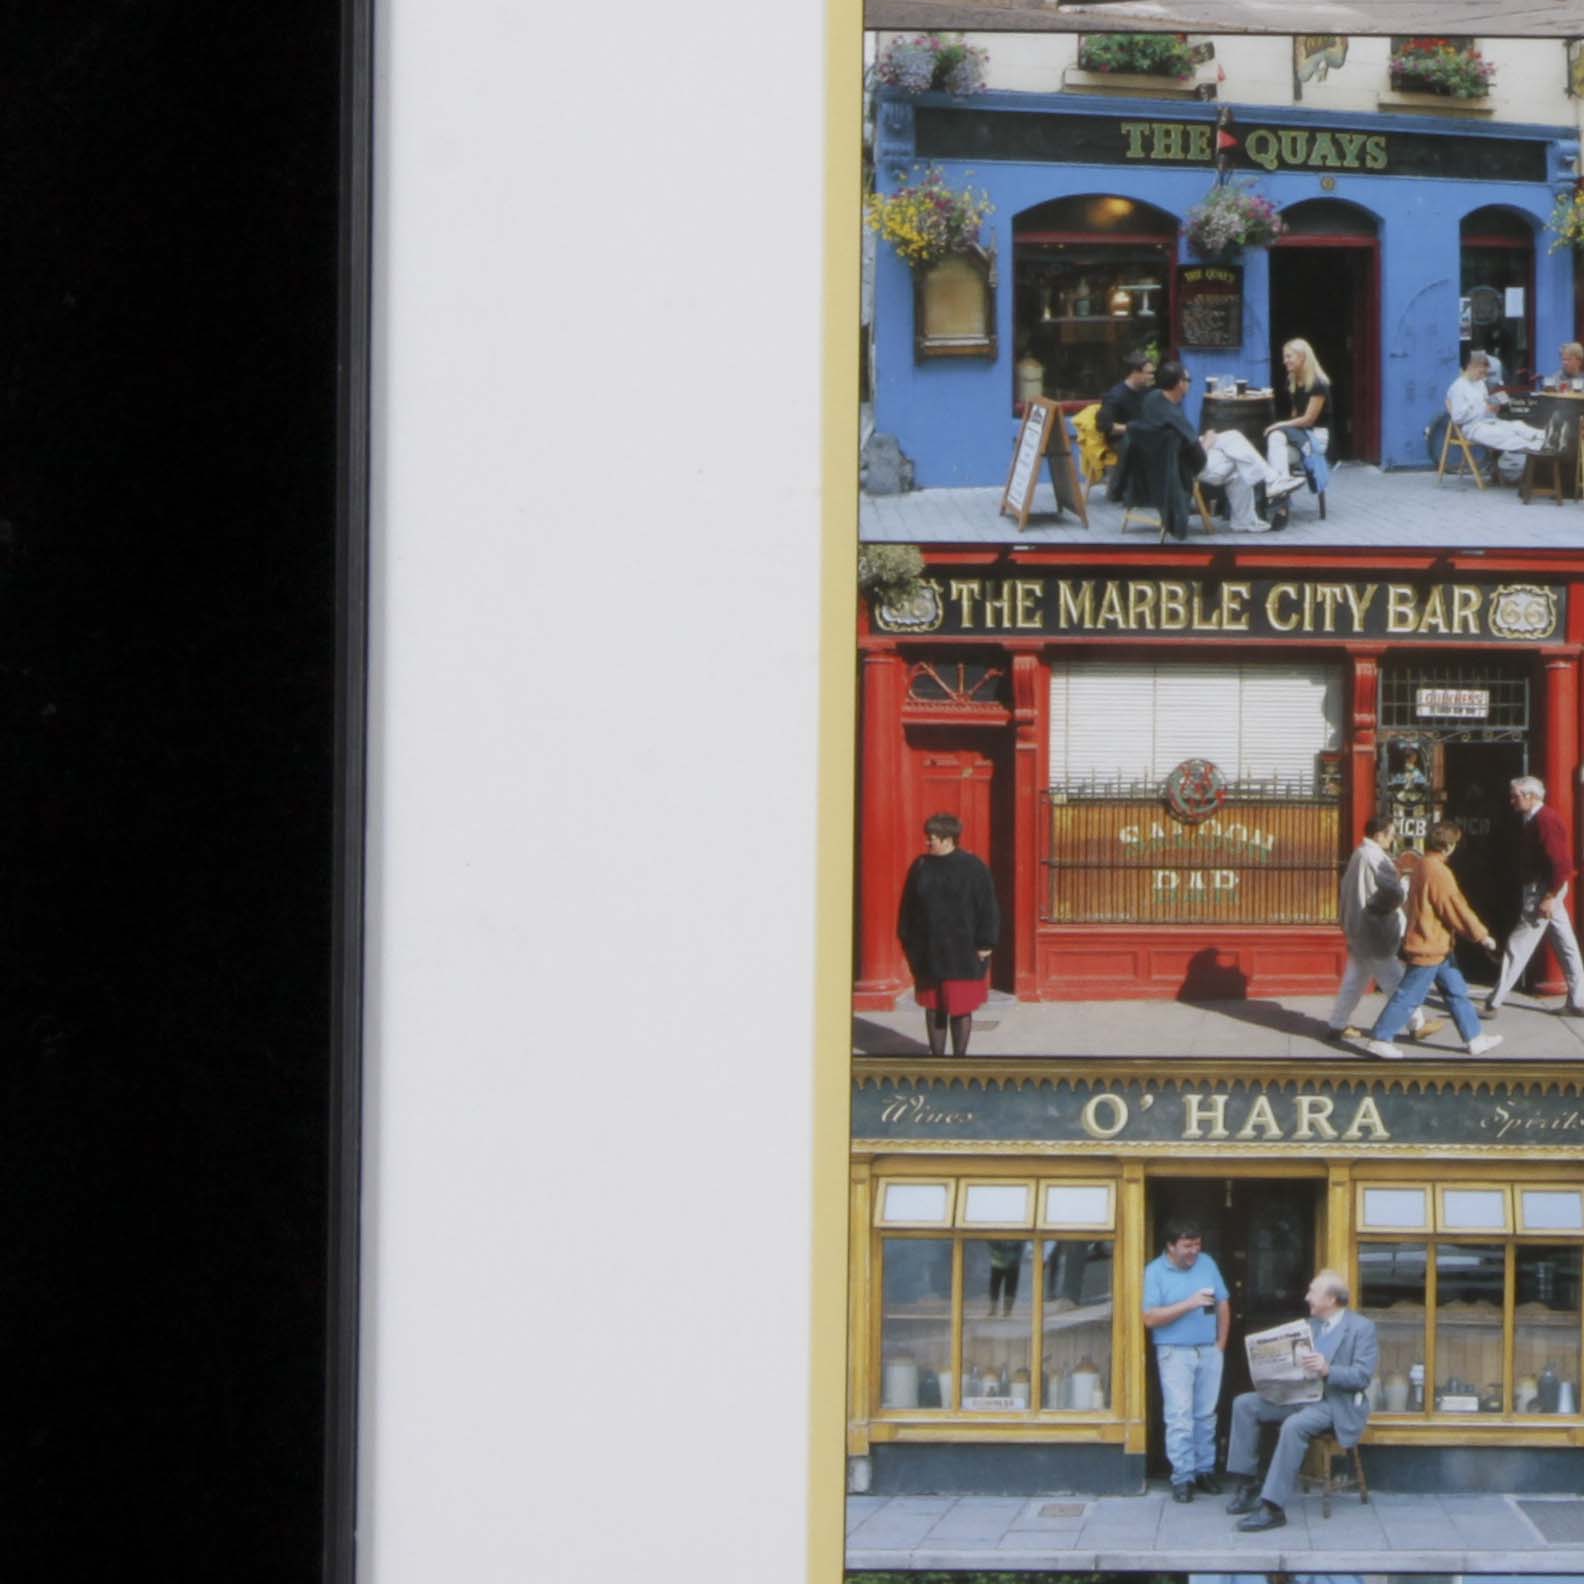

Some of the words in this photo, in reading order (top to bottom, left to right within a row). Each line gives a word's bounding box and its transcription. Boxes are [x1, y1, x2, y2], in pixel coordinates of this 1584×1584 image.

[1121, 121, 1212, 160] THE
[1245, 128, 1388, 171] QUAYS
[951, 578, 1044, 628] THE
[1059, 581, 1250, 630] MARBLE
[1266, 582, 1375, 632] CITY
[1388, 584, 1482, 634] BAR
[881, 1095, 973, 1124] Wines
[1182, 1094, 1391, 1142] HARA
